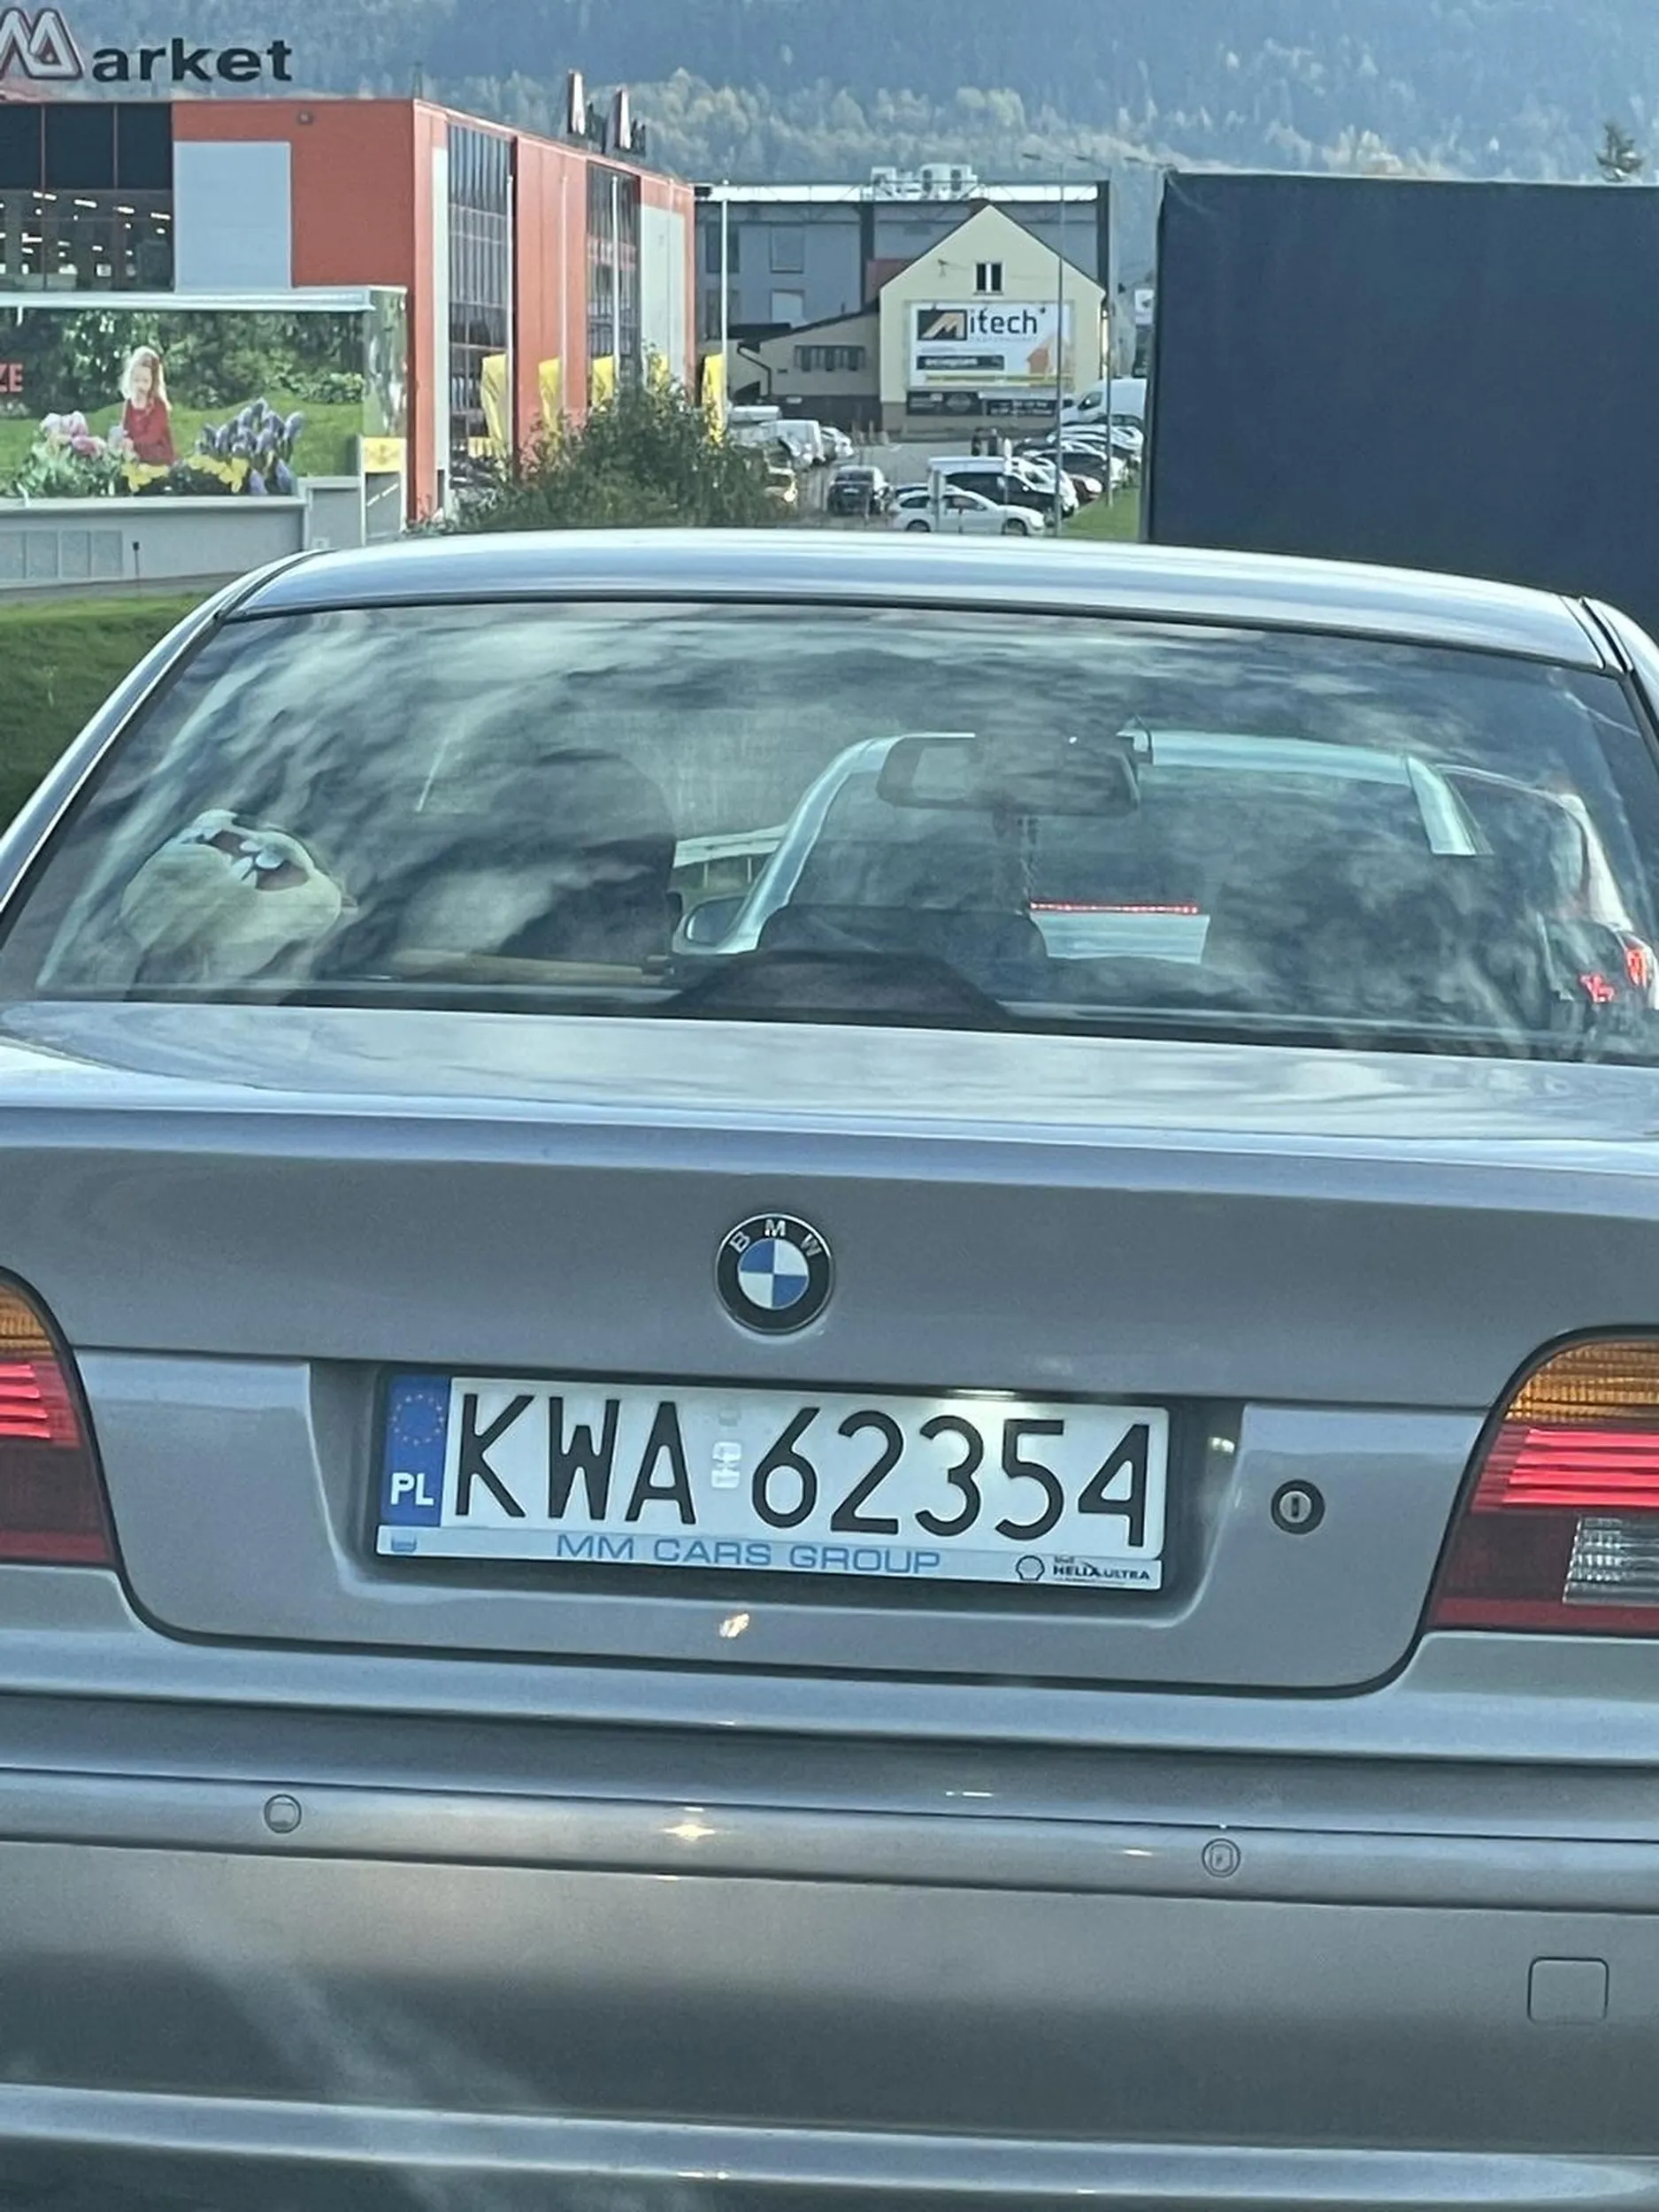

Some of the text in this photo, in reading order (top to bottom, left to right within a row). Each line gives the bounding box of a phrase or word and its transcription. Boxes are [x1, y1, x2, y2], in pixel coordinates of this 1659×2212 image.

[729, 1218, 823, 1257] BMW
[390, 1472, 434, 1506] PL
[455, 1393, 1151, 1548] KWA 62354
[556, 1532, 941, 1575] MM CARS GROUP
[1102, 1568, 1151, 1580] ULTRA
